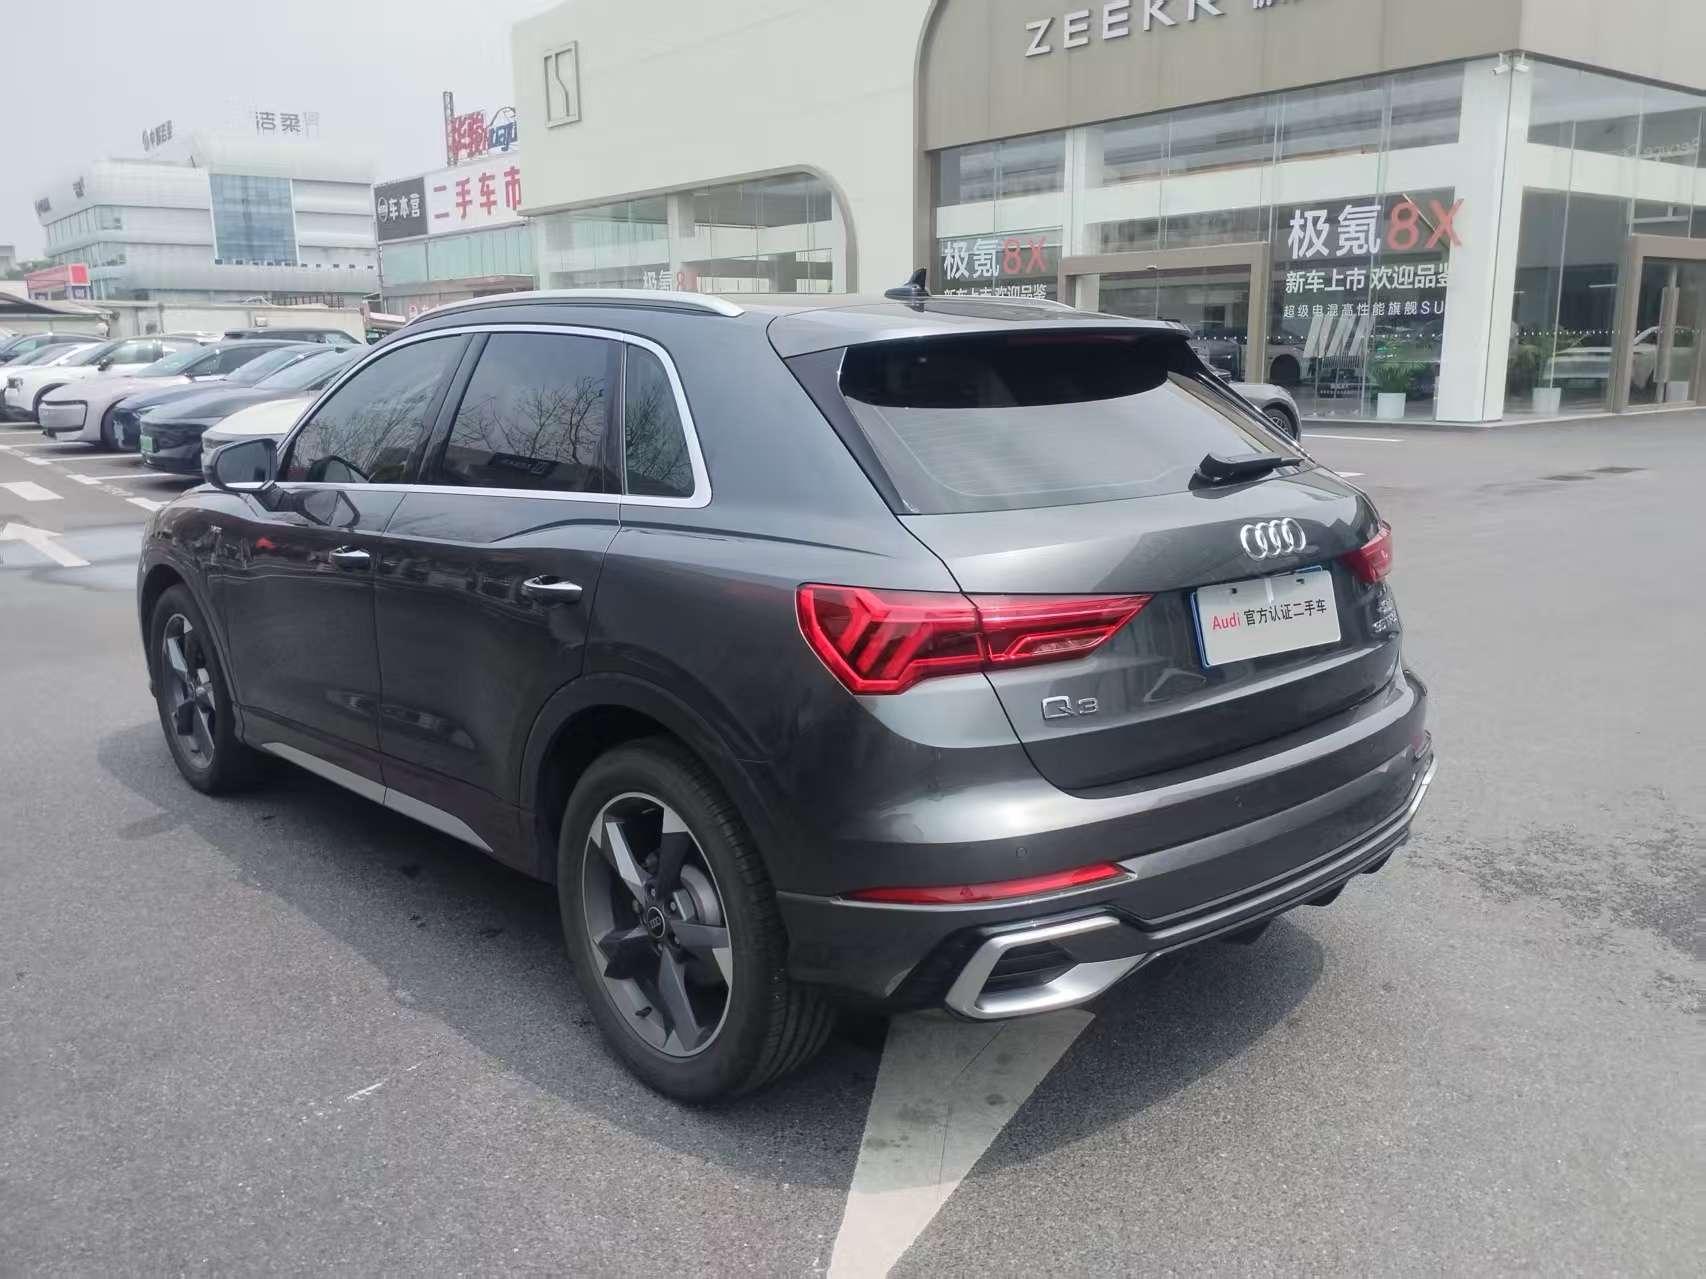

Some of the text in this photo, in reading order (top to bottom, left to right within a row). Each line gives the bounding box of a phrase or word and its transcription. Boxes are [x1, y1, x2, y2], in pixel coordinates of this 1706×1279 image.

[432, 165, 522, 220] 二手车市
[1287, 198, 1465, 260] 极氪8X
[943, 236, 1048, 280] 极氪8X
[1285, 266, 1367, 294] 新车上市
[1212, 598, 1328, 631] Audi 官方认证二手车
[1041, 695, 1098, 720] Q3
